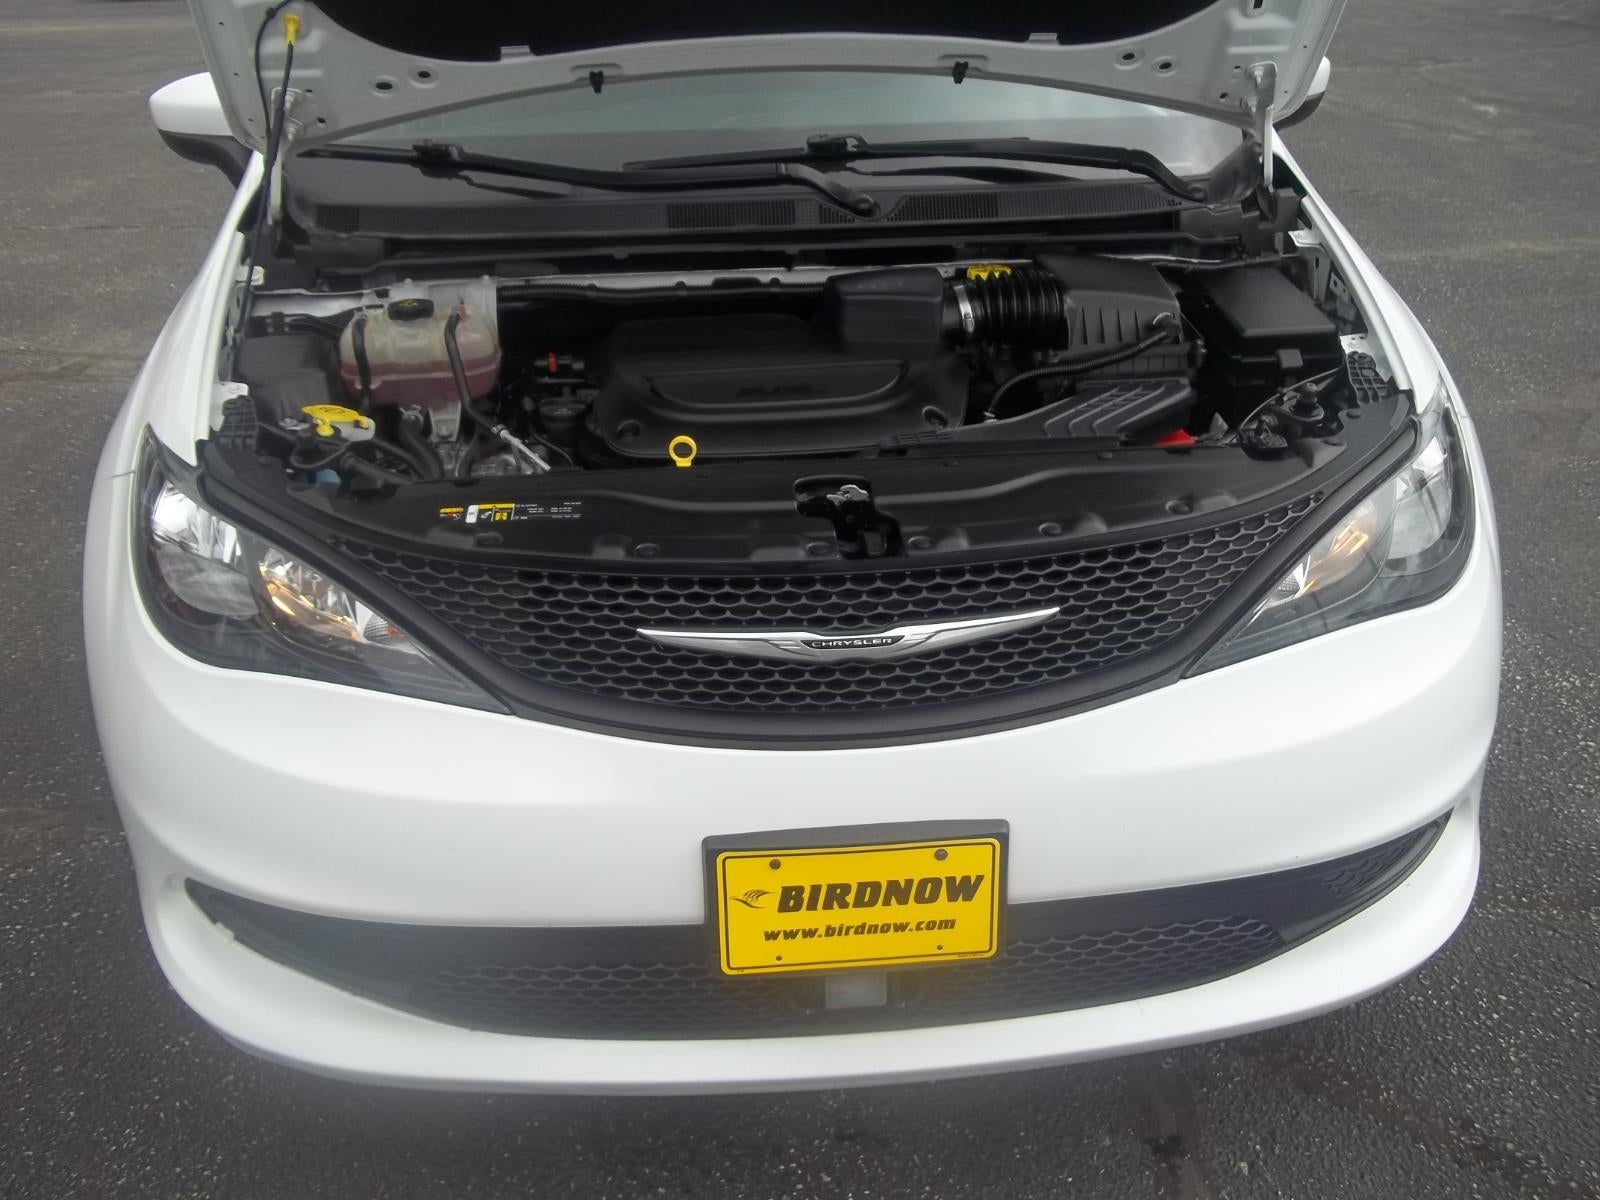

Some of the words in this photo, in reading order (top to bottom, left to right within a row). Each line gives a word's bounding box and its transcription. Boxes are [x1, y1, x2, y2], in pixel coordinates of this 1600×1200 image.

[811, 638, 892, 648] CHRYSLER
[777, 875, 984, 913] BIRDNOW
[763, 918, 956, 941] www.birdnow.com
